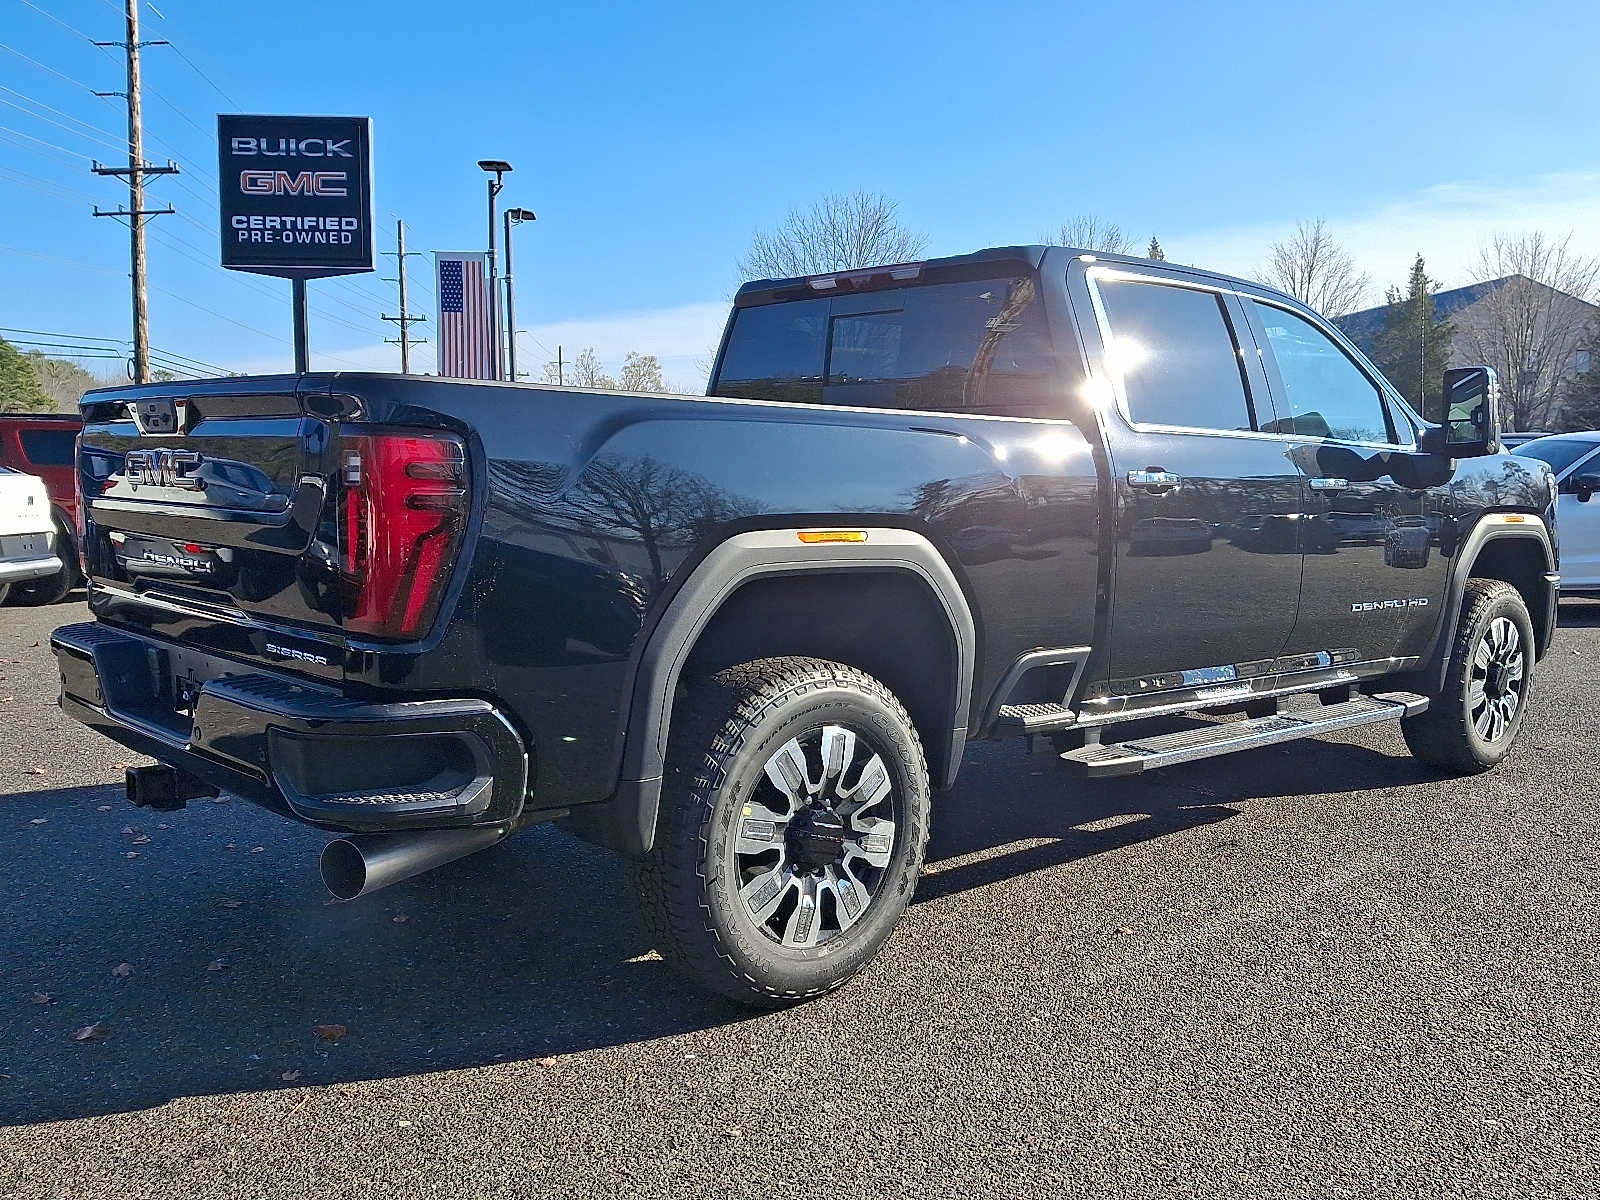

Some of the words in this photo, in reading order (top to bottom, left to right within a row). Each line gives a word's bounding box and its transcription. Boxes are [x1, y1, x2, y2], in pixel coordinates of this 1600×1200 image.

[231, 137, 353, 158] BUICK
[240, 169, 348, 197] GMC
[231, 215, 358, 231] CERTIFIED
[238, 230, 352, 244] PRE-OWNED
[125, 447, 204, 489] GMC
[143, 551, 214, 574] DENALI
[1351, 599, 1406, 612] DENALI
[1408, 597, 1429, 607] HD
[266, 643, 328, 665] SIERRA
